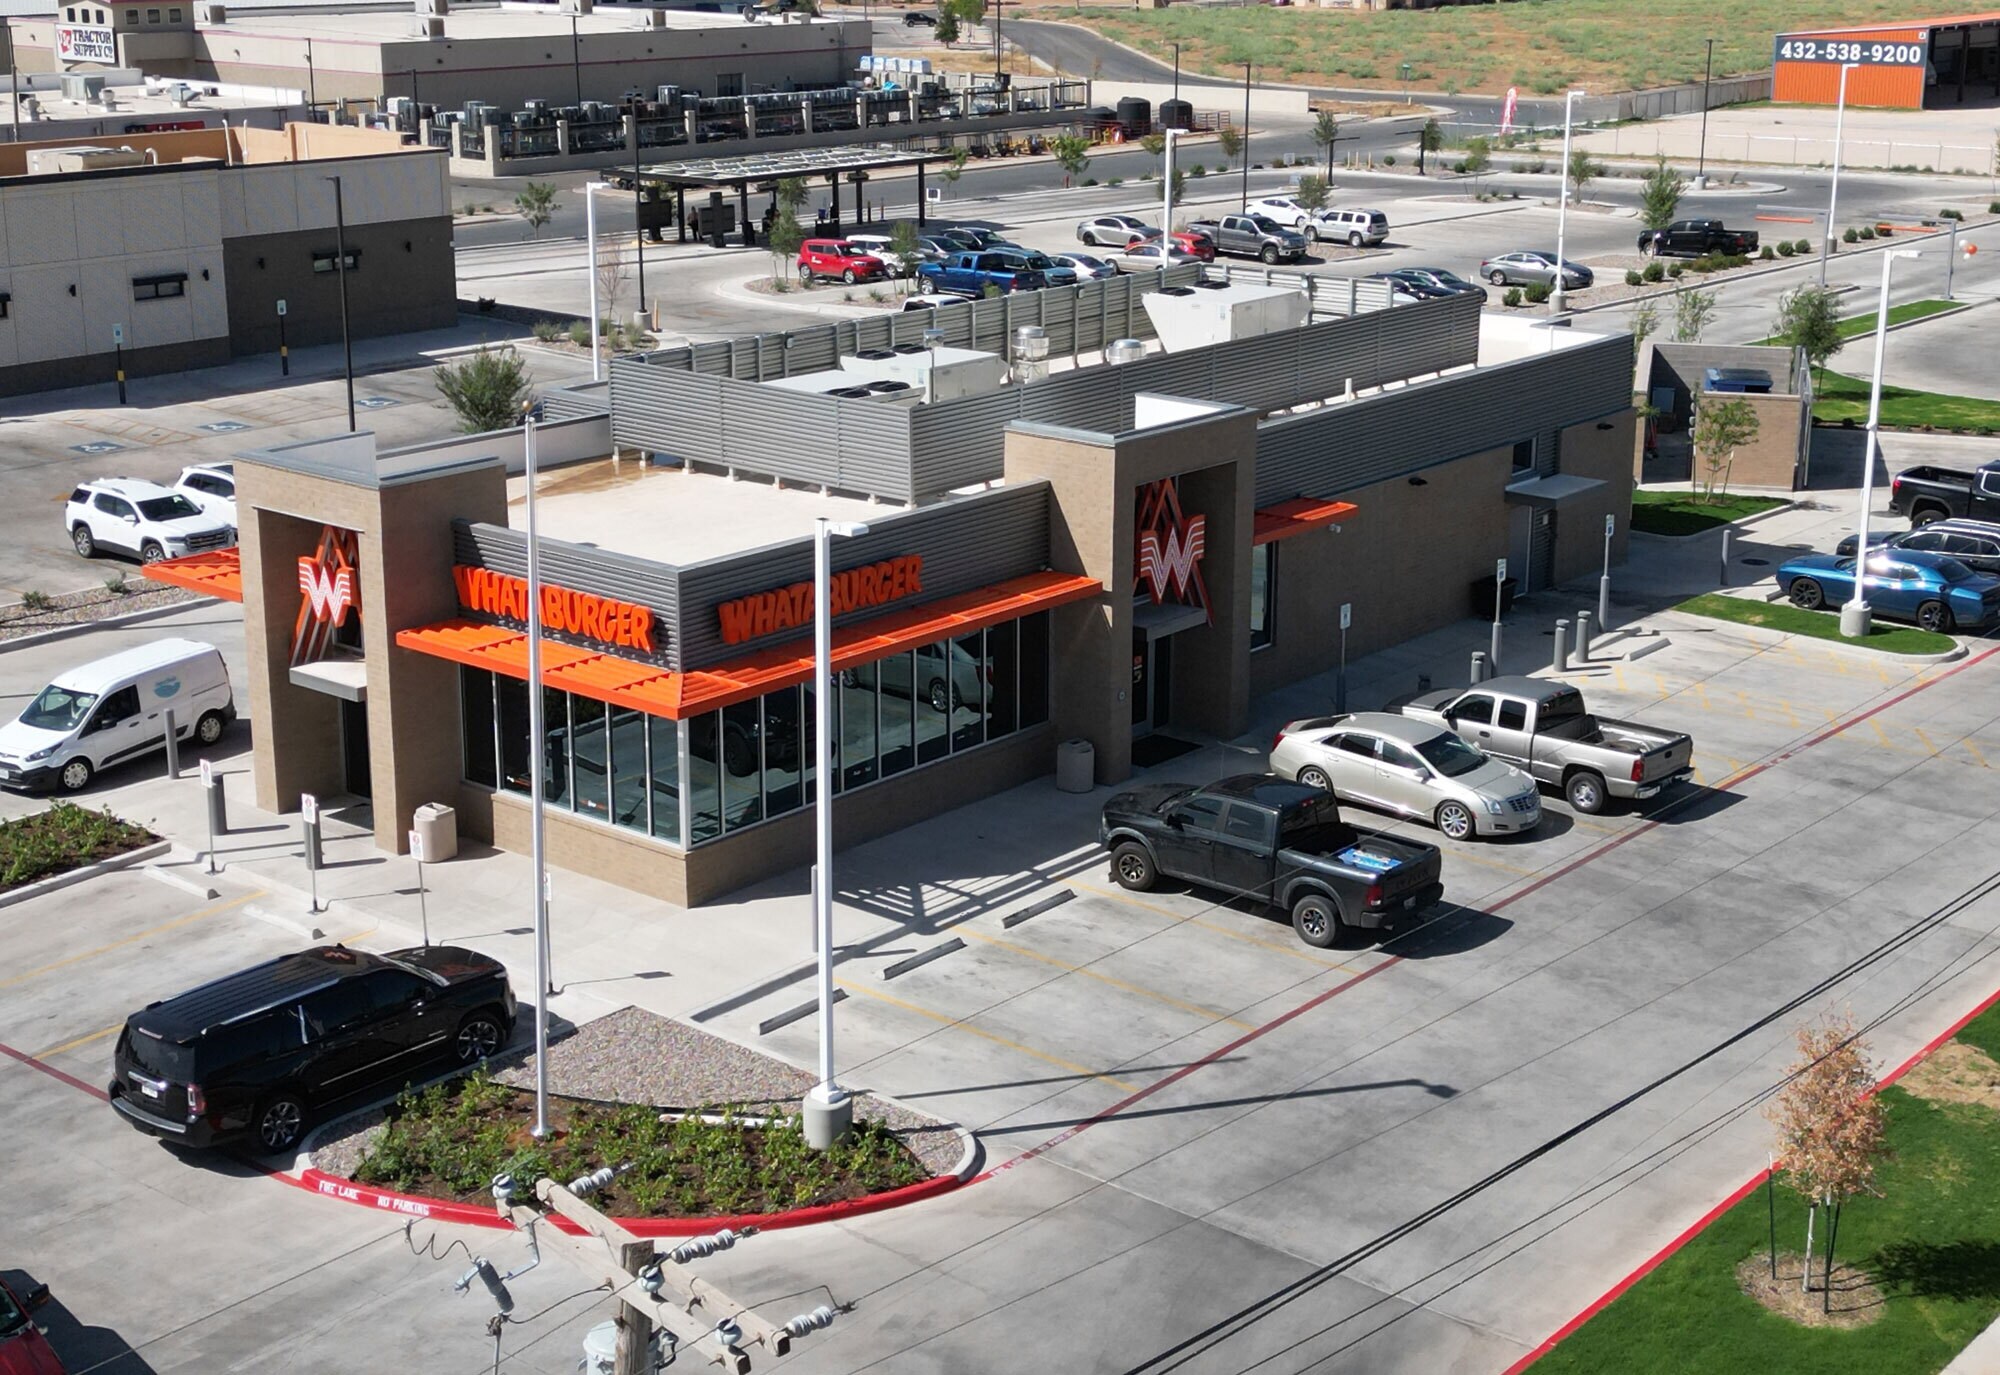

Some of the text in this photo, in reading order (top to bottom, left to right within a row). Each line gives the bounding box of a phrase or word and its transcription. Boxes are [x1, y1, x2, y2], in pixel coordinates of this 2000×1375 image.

[73, 29, 112, 44] TRACTOR
[73, 43, 103, 58] SUPPLY
[1781, 42, 1921, 63] 432-538-9200
[393, 1198, 430, 1216] PARKING
